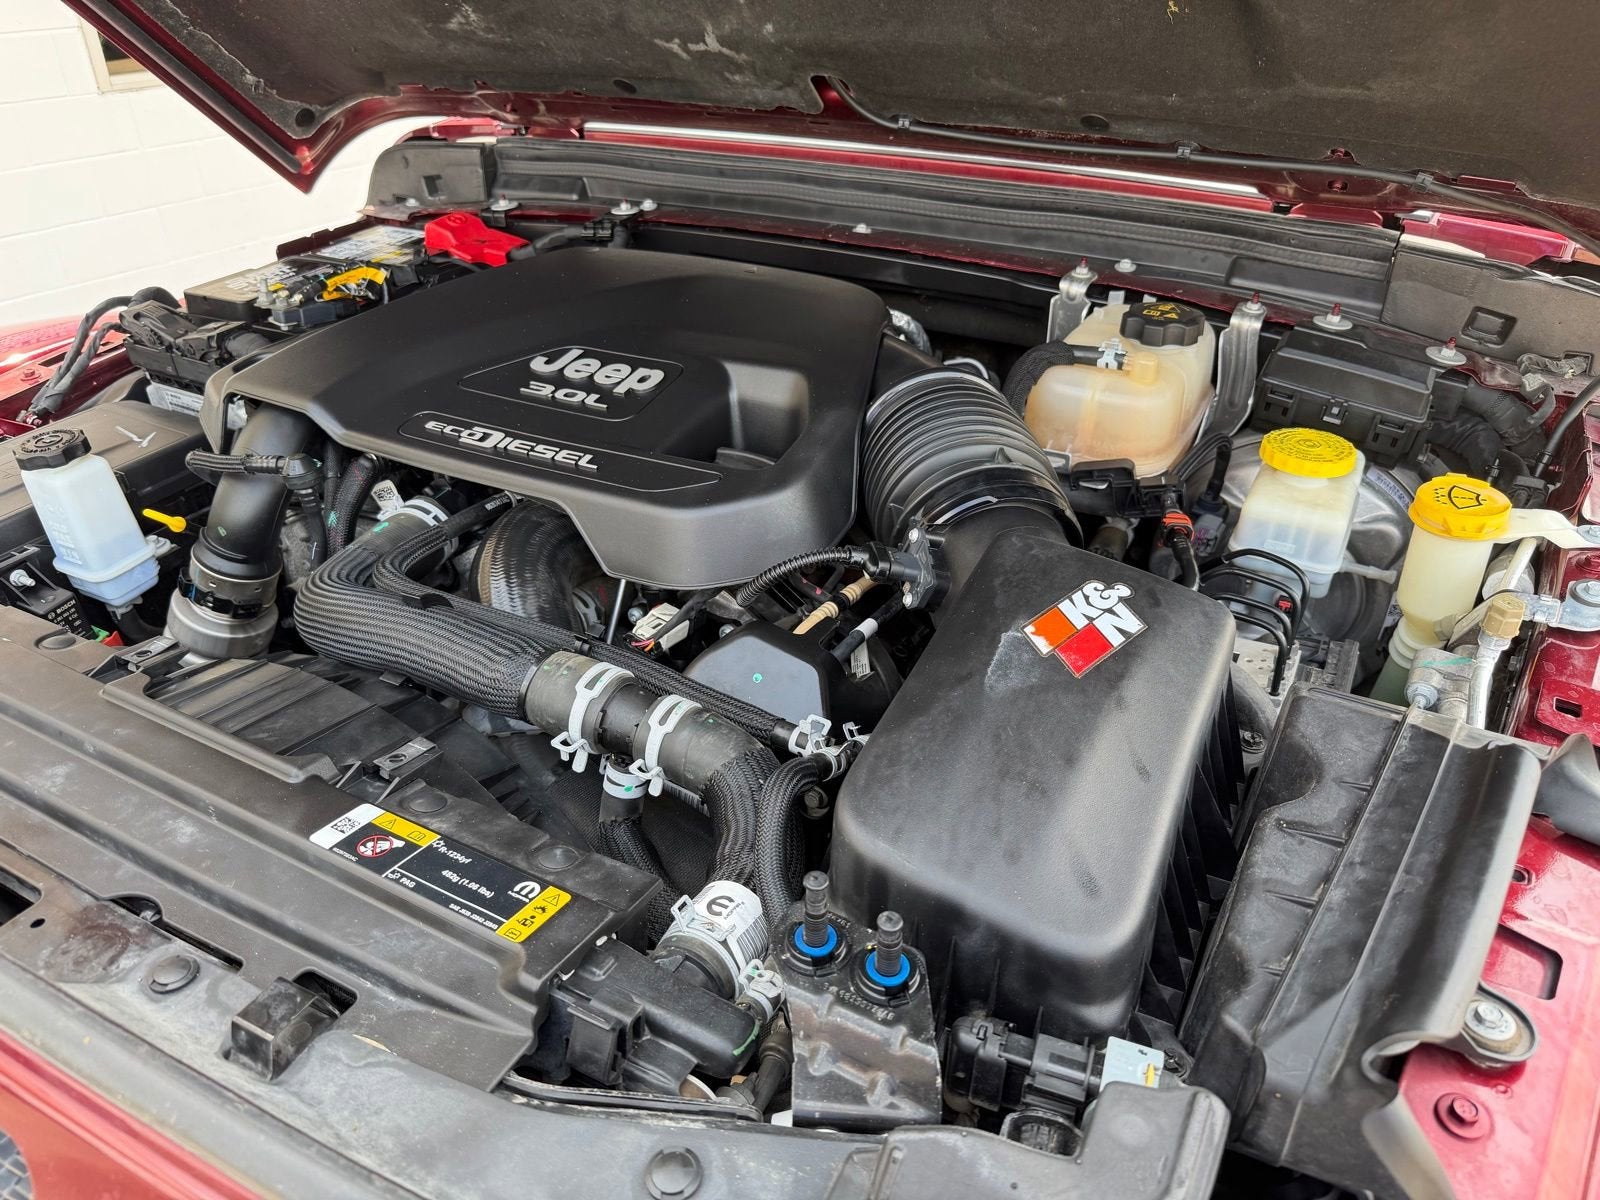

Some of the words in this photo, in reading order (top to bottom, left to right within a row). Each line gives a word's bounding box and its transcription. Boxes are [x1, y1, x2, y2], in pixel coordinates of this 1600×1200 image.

[529, 347, 665, 396] Jeep
[519, 380, 608, 410] 3.0L
[424, 420, 599, 472] ECODIESEL
[56, 599, 76, 614] BOSCH
[1056, 581, 1144, 648] K&N
[438, 846, 472, 864] R-1234yf
[399, 877, 416, 888] PAG
[441, 869, 459, 883] 482g
[477, 885, 495, 899] lbs)
